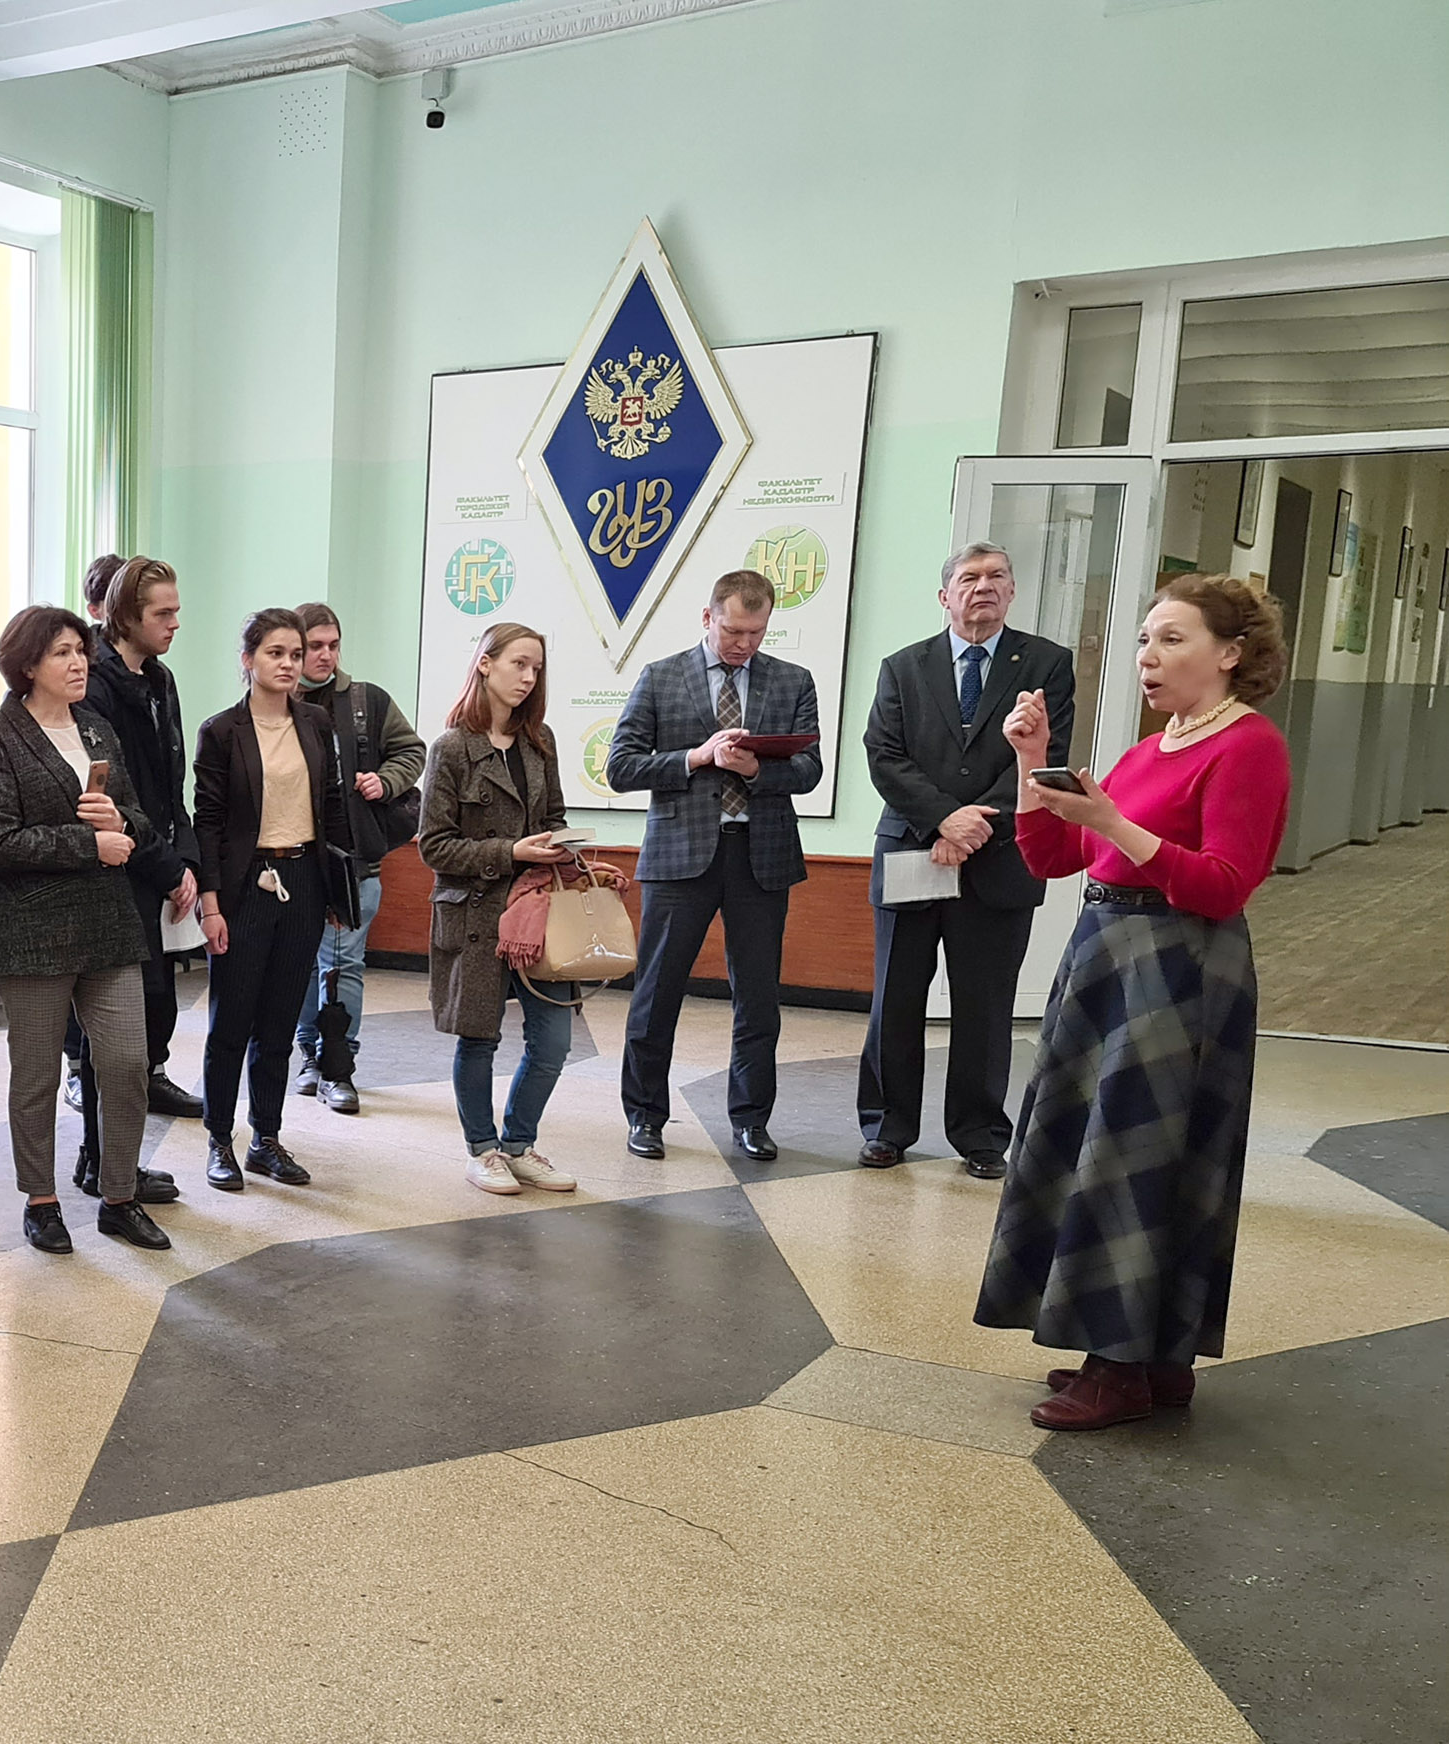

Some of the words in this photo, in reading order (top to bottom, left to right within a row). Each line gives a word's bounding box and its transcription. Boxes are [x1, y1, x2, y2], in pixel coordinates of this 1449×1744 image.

[758, 478, 822, 487] ФАКУЛЬТЕТ
[763, 487, 815, 496] КАДАСТР
[458, 553, 501, 603] ГК
[756, 540, 817, 593] КН
